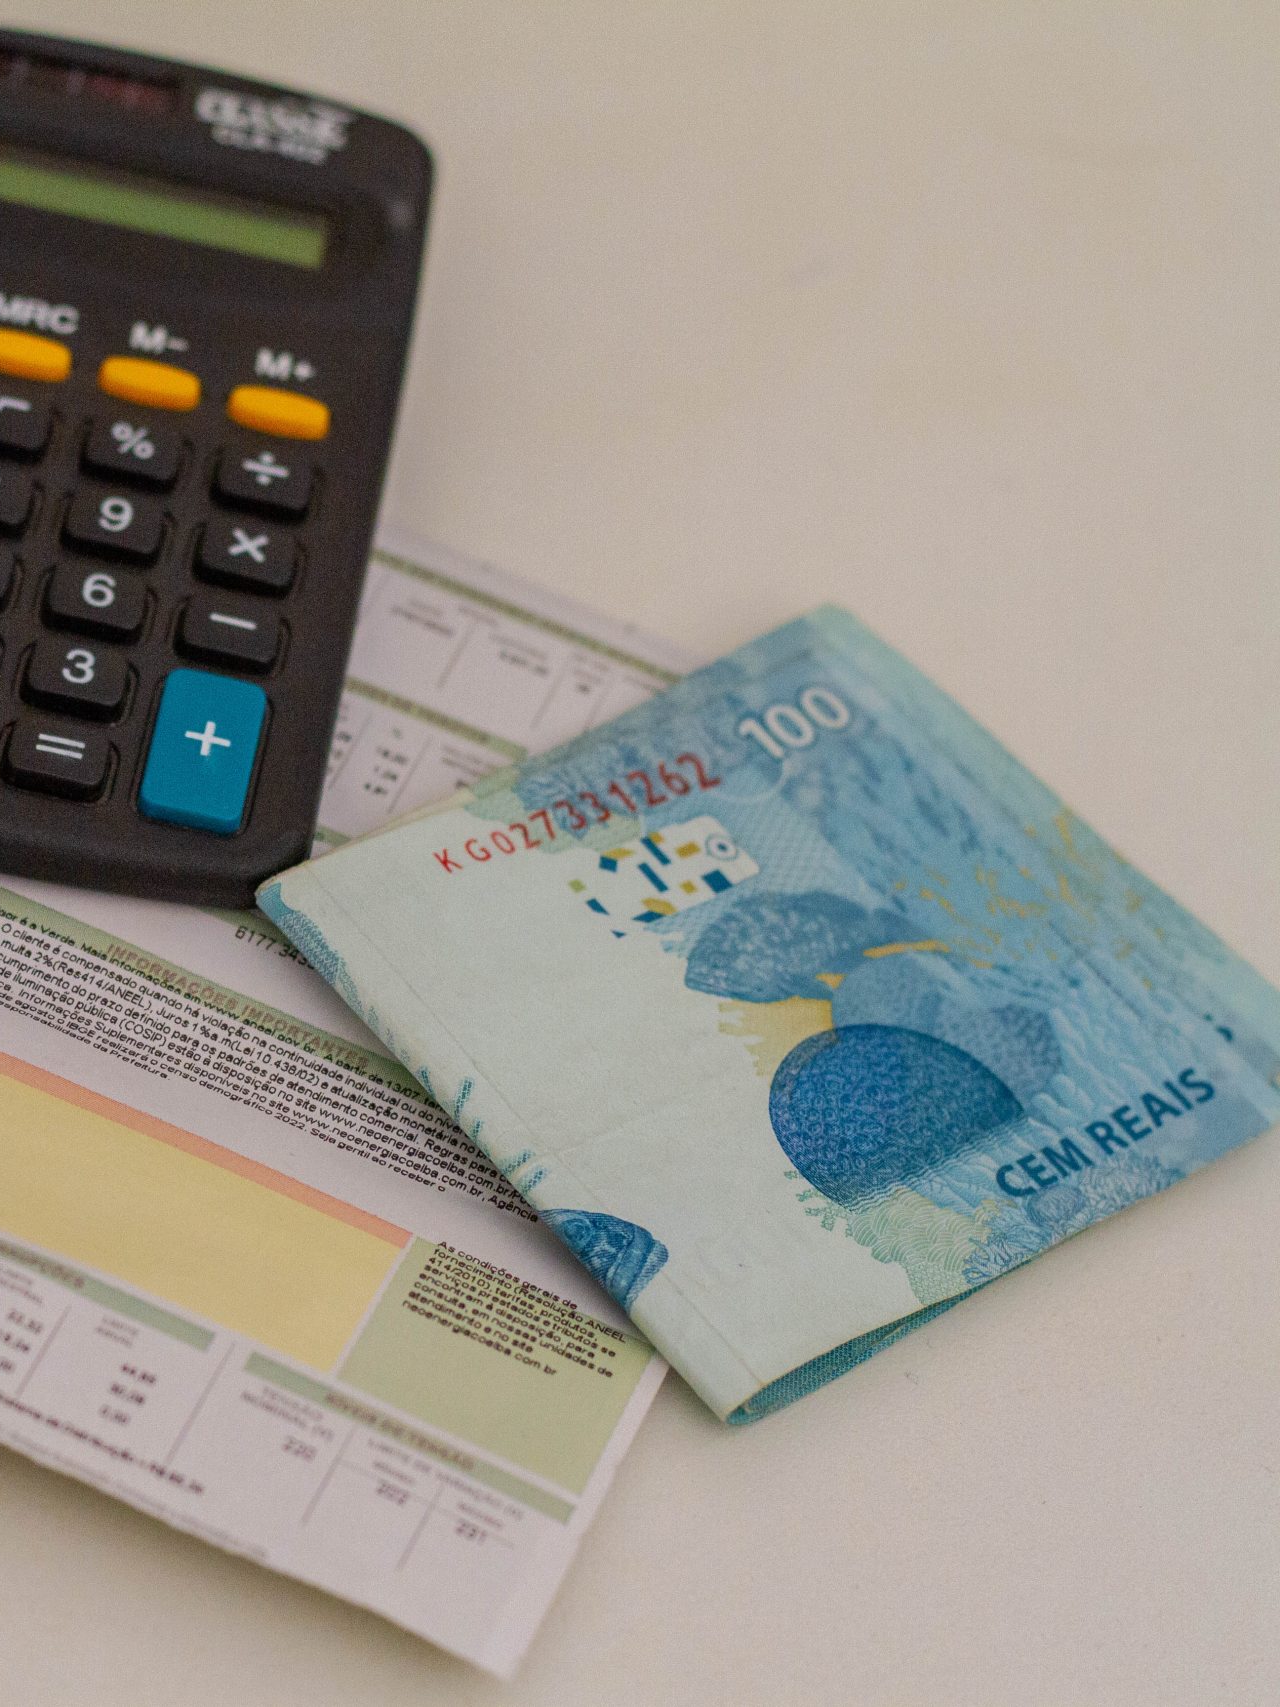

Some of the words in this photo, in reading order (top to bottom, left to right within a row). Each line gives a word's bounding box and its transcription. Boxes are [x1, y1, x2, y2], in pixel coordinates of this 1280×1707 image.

[99, 498, 131, 531] 9
[82, 574, 116, 607] 6
[63, 650, 95, 685] 3
[738, 686, 851, 759] 100
[1, 940, 32, 958] multa
[156, 1008, 189, 1027] Juros
[331, 1086, 398, 1120] atualização
[400, 1116, 458, 1146] monetária
[13, 930, 50, 950] cliente
[62, 951, 137, 988] compensado
[139, 986, 182, 1010] quando
[203, 1014, 250, 1040] violação
[269, 1045, 343, 1081] continuidade
[345, 1076, 401, 1106] individual
[13, 972, 74, 1005] iluminação
[74, 1001, 118, 1024] pública
[168, 1043, 201, 1061] estão
[213, 1062, 276, 1094] disposição
[295, 1099, 316, 1112] site
[19, 989, 92, 1026] Informações
[92, 1022, 181, 1065] Suplementares
[184, 1063, 250, 1095] disponíveis
[87, 993, 123, 1012] prazo
[124, 1008, 171, 1034] definido
[171, 1031, 199, 1050] para
[217, 1051, 267, 1077] padrões
[287, 1081, 358, 1117] atendimento
[424, 1139, 468, 1165] Regras
[995, 1134, 1095, 1201] CEM
[1085, 1067, 1217, 1157] REAIS
